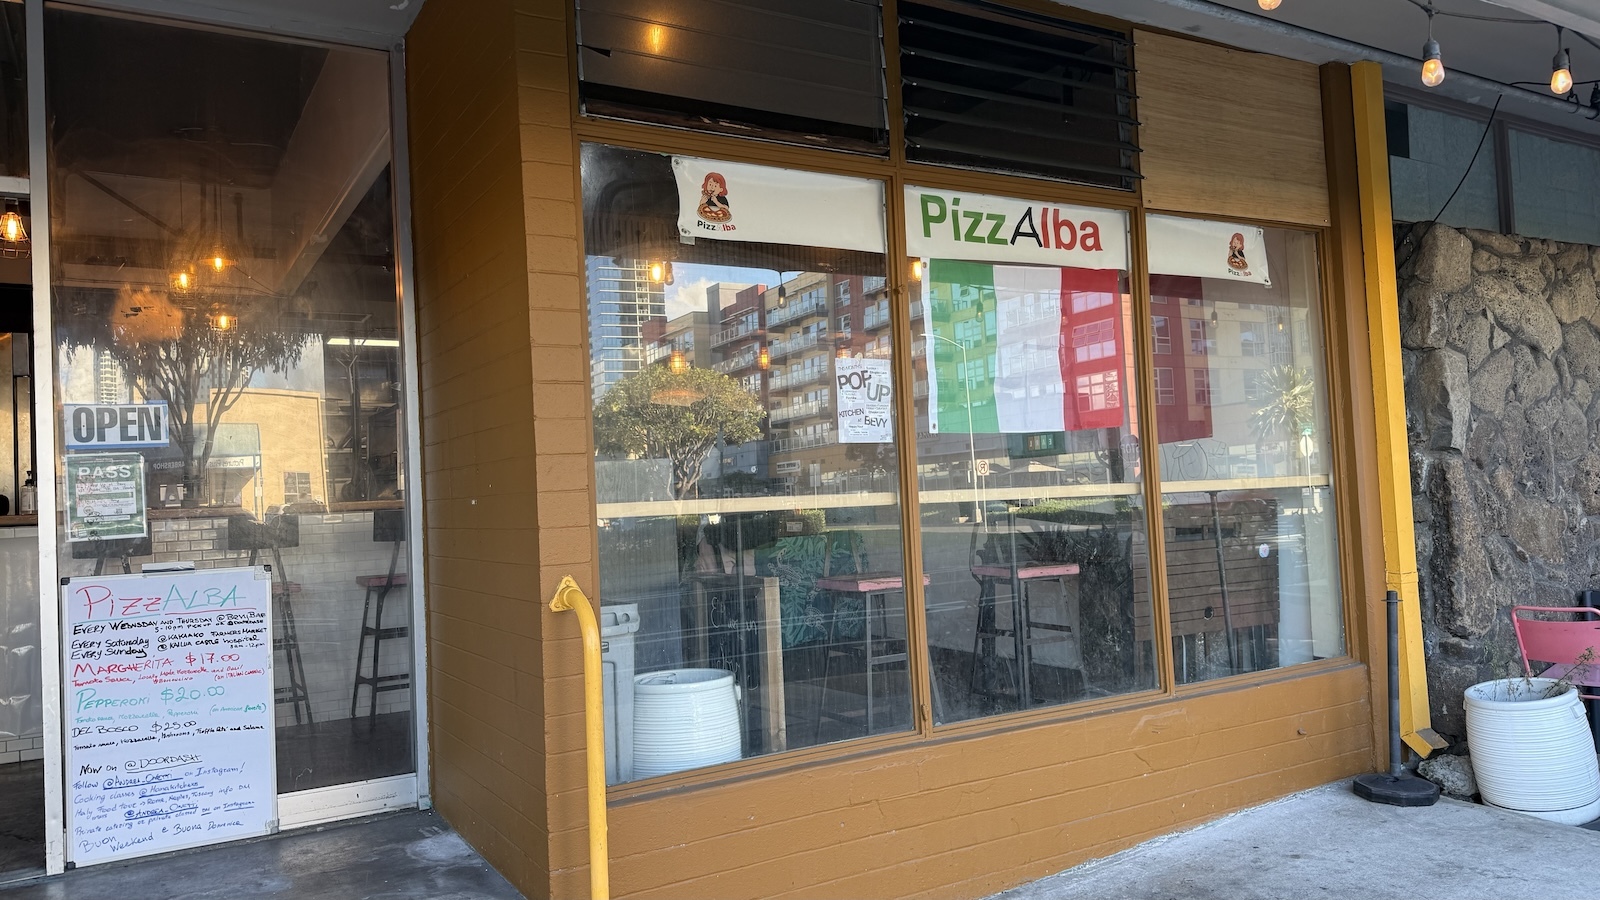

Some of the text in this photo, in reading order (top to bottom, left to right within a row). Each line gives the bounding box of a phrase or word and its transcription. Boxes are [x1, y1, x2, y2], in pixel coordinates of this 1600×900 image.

[920, 193, 1103, 252] PizzAlba
[1228, 268, 1252, 277] Pizzlba
[837, 370, 872, 390] POP
[867, 382, 891, 402] UP
[839, 408, 865, 418] KITCHEN
[72, 407, 162, 443] OPEN
[864, 415, 888, 428] BEVY
[78, 464, 132, 480] PASS
[105, 636, 150, 649] Saturday
[105, 647, 147, 658] Sunday
[73, 658, 174, 678] MARGHERITA
[160, 685, 225, 705] $20.00
[72, 727, 93, 738] DEL
[150, 720, 197, 734] $25.00
[79, 763, 102, 776] Now
[73, 781, 99, 790] Follow
[74, 794, 105, 804] Cooking
[97, 804, 117, 813] Food
[106, 822, 133, 830] catering
[79, 835, 117, 853] Buon
[173, 824, 202, 835] Buona
